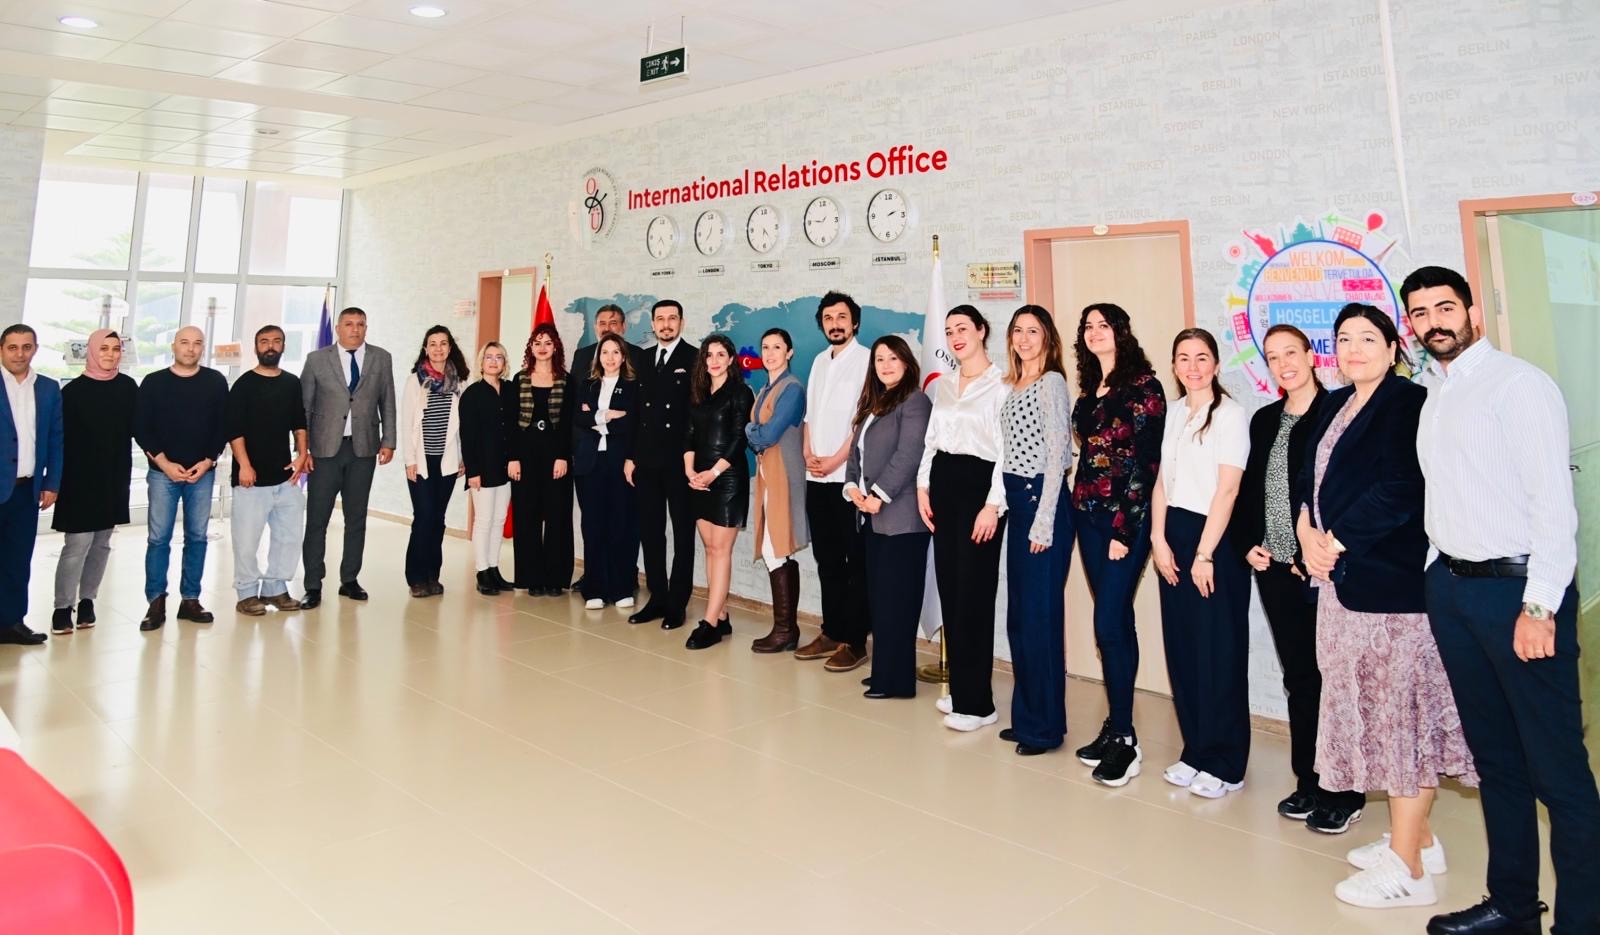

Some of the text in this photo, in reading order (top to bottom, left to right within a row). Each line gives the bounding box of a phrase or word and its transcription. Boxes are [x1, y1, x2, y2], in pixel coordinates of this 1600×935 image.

[1185, 29, 1218, 41] PARIS
[1233, 31, 1280, 46] LONDON
[1457, 39, 1510, 56] BERLIN
[1031, 66, 1067, 80] LONDON
[1323, 64, 1385, 82] ISTANBUL
[1202, 78, 1241, 91] BERLIN
[1408, 88, 1461, 104] SYDNEY
[1099, 98, 1146, 112] ISTANBUL
[1273, 102, 1335, 118] NEW YORK
[1006, 108, 1036, 120] BERLIN
[1164, 120, 1204, 132] SYDNEY
[1449, 115, 1490, 128] PARIS
[1513, 120, 1578, 137] LONDON
[1242, 149, 1290, 162] LONDON
[1127, 160, 1165, 171] TURKEY
[628, 169, 749, 210] International
[754, 160, 860, 194] Relations
[866, 145, 947, 178] Office
[1471, 174, 1525, 188] BERLIN
[1210, 194, 1250, 206] BERLIN
[1333, 192, 1397, 206] ISTANBUL
[1105, 208, 1153, 220] ISTANBUL
[1289, 250, 1345, 268] WELKOM
